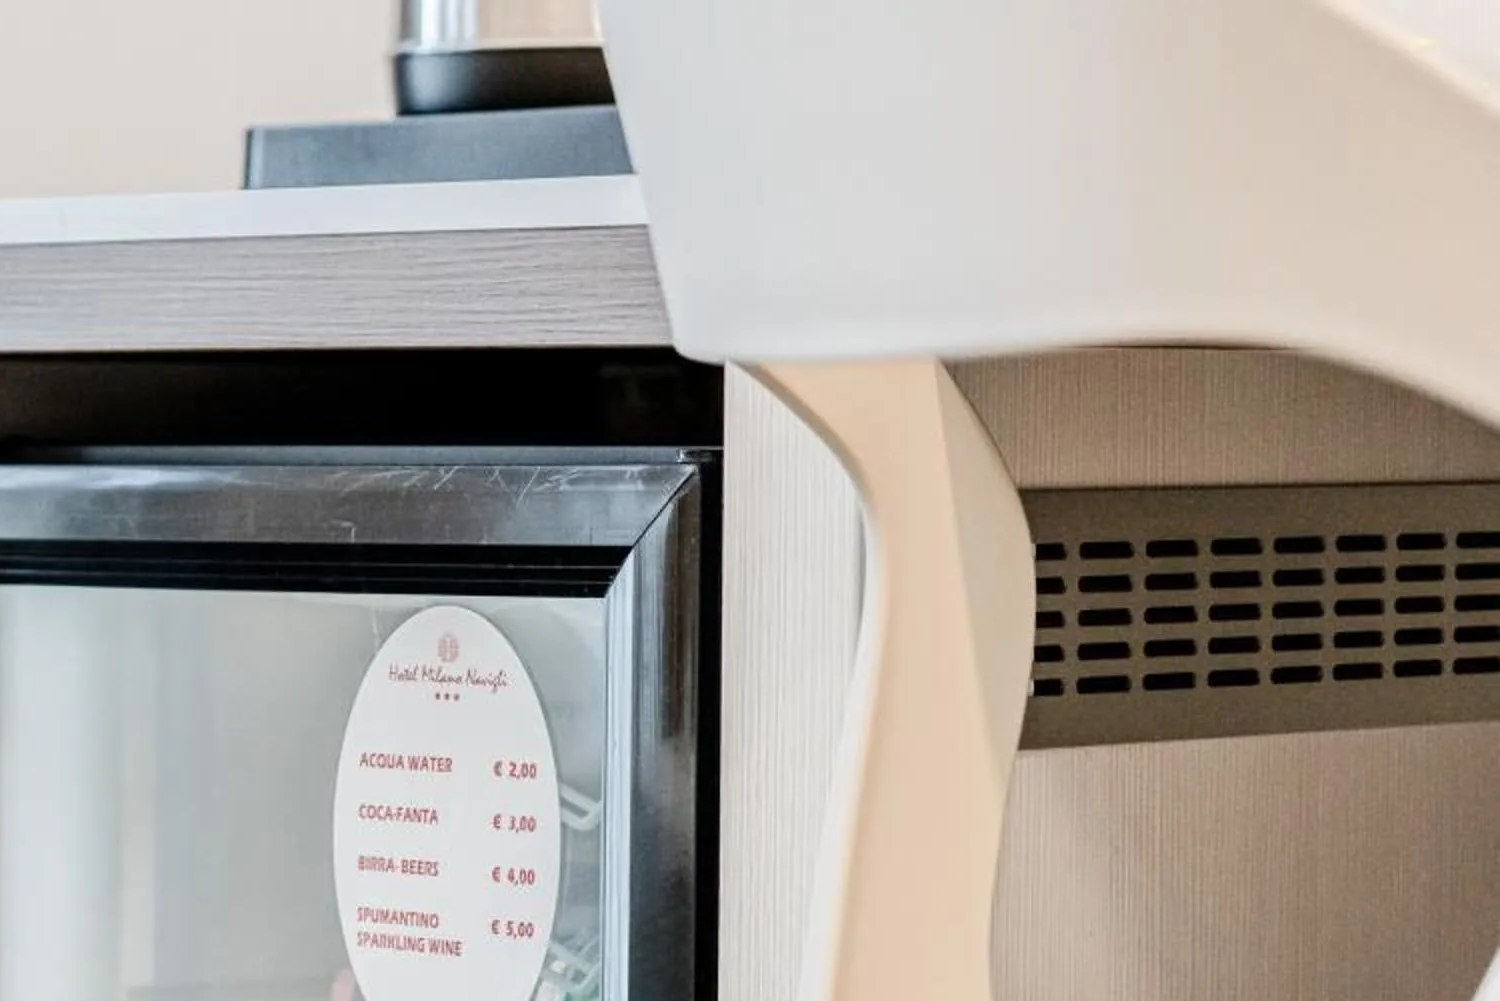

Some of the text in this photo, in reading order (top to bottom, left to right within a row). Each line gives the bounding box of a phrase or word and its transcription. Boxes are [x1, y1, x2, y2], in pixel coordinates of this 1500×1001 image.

[389, 663, 509, 694] Hotel Milano Navigli
[359, 752, 453, 773] ACQUA WATER
[493, 760, 538, 780] € 2,00
[358, 803, 439, 825] COCA-FANTA
[492, 813, 537, 834] € 3,00
[491, 866, 536, 886] € 4,00
[356, 906, 440, 930] SPUMANTINO
[491, 919, 535, 940] € 5,00
[357, 931, 463, 957] SPARKLING WINE
